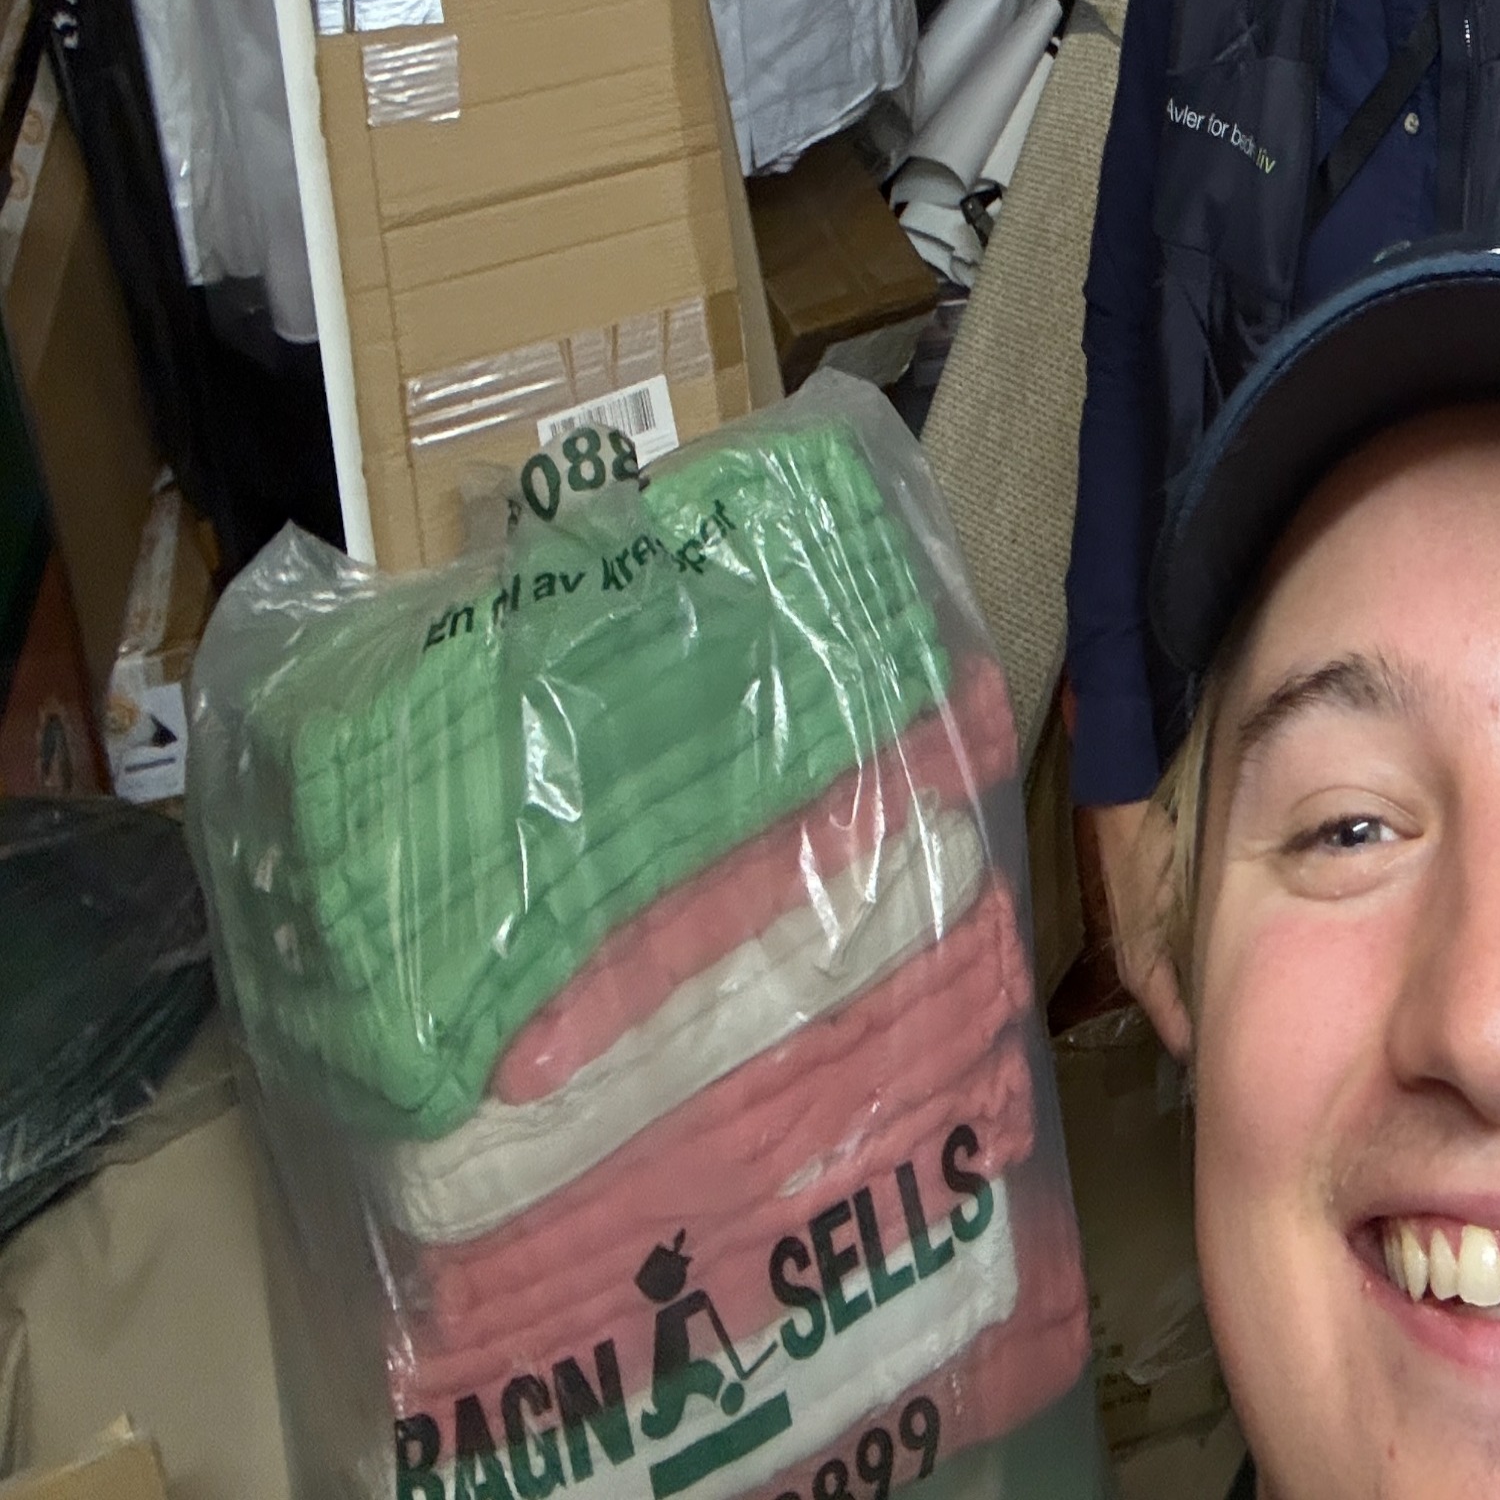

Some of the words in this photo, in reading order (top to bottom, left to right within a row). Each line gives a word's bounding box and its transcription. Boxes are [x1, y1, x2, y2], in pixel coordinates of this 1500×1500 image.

[1166, 97, 1205, 131] Avler
[1207, 113, 1230, 138] for
[1255, 147, 1276, 174] liv
[533, 571, 586, 602] av
[768, 1123, 995, 1360] SELLS
